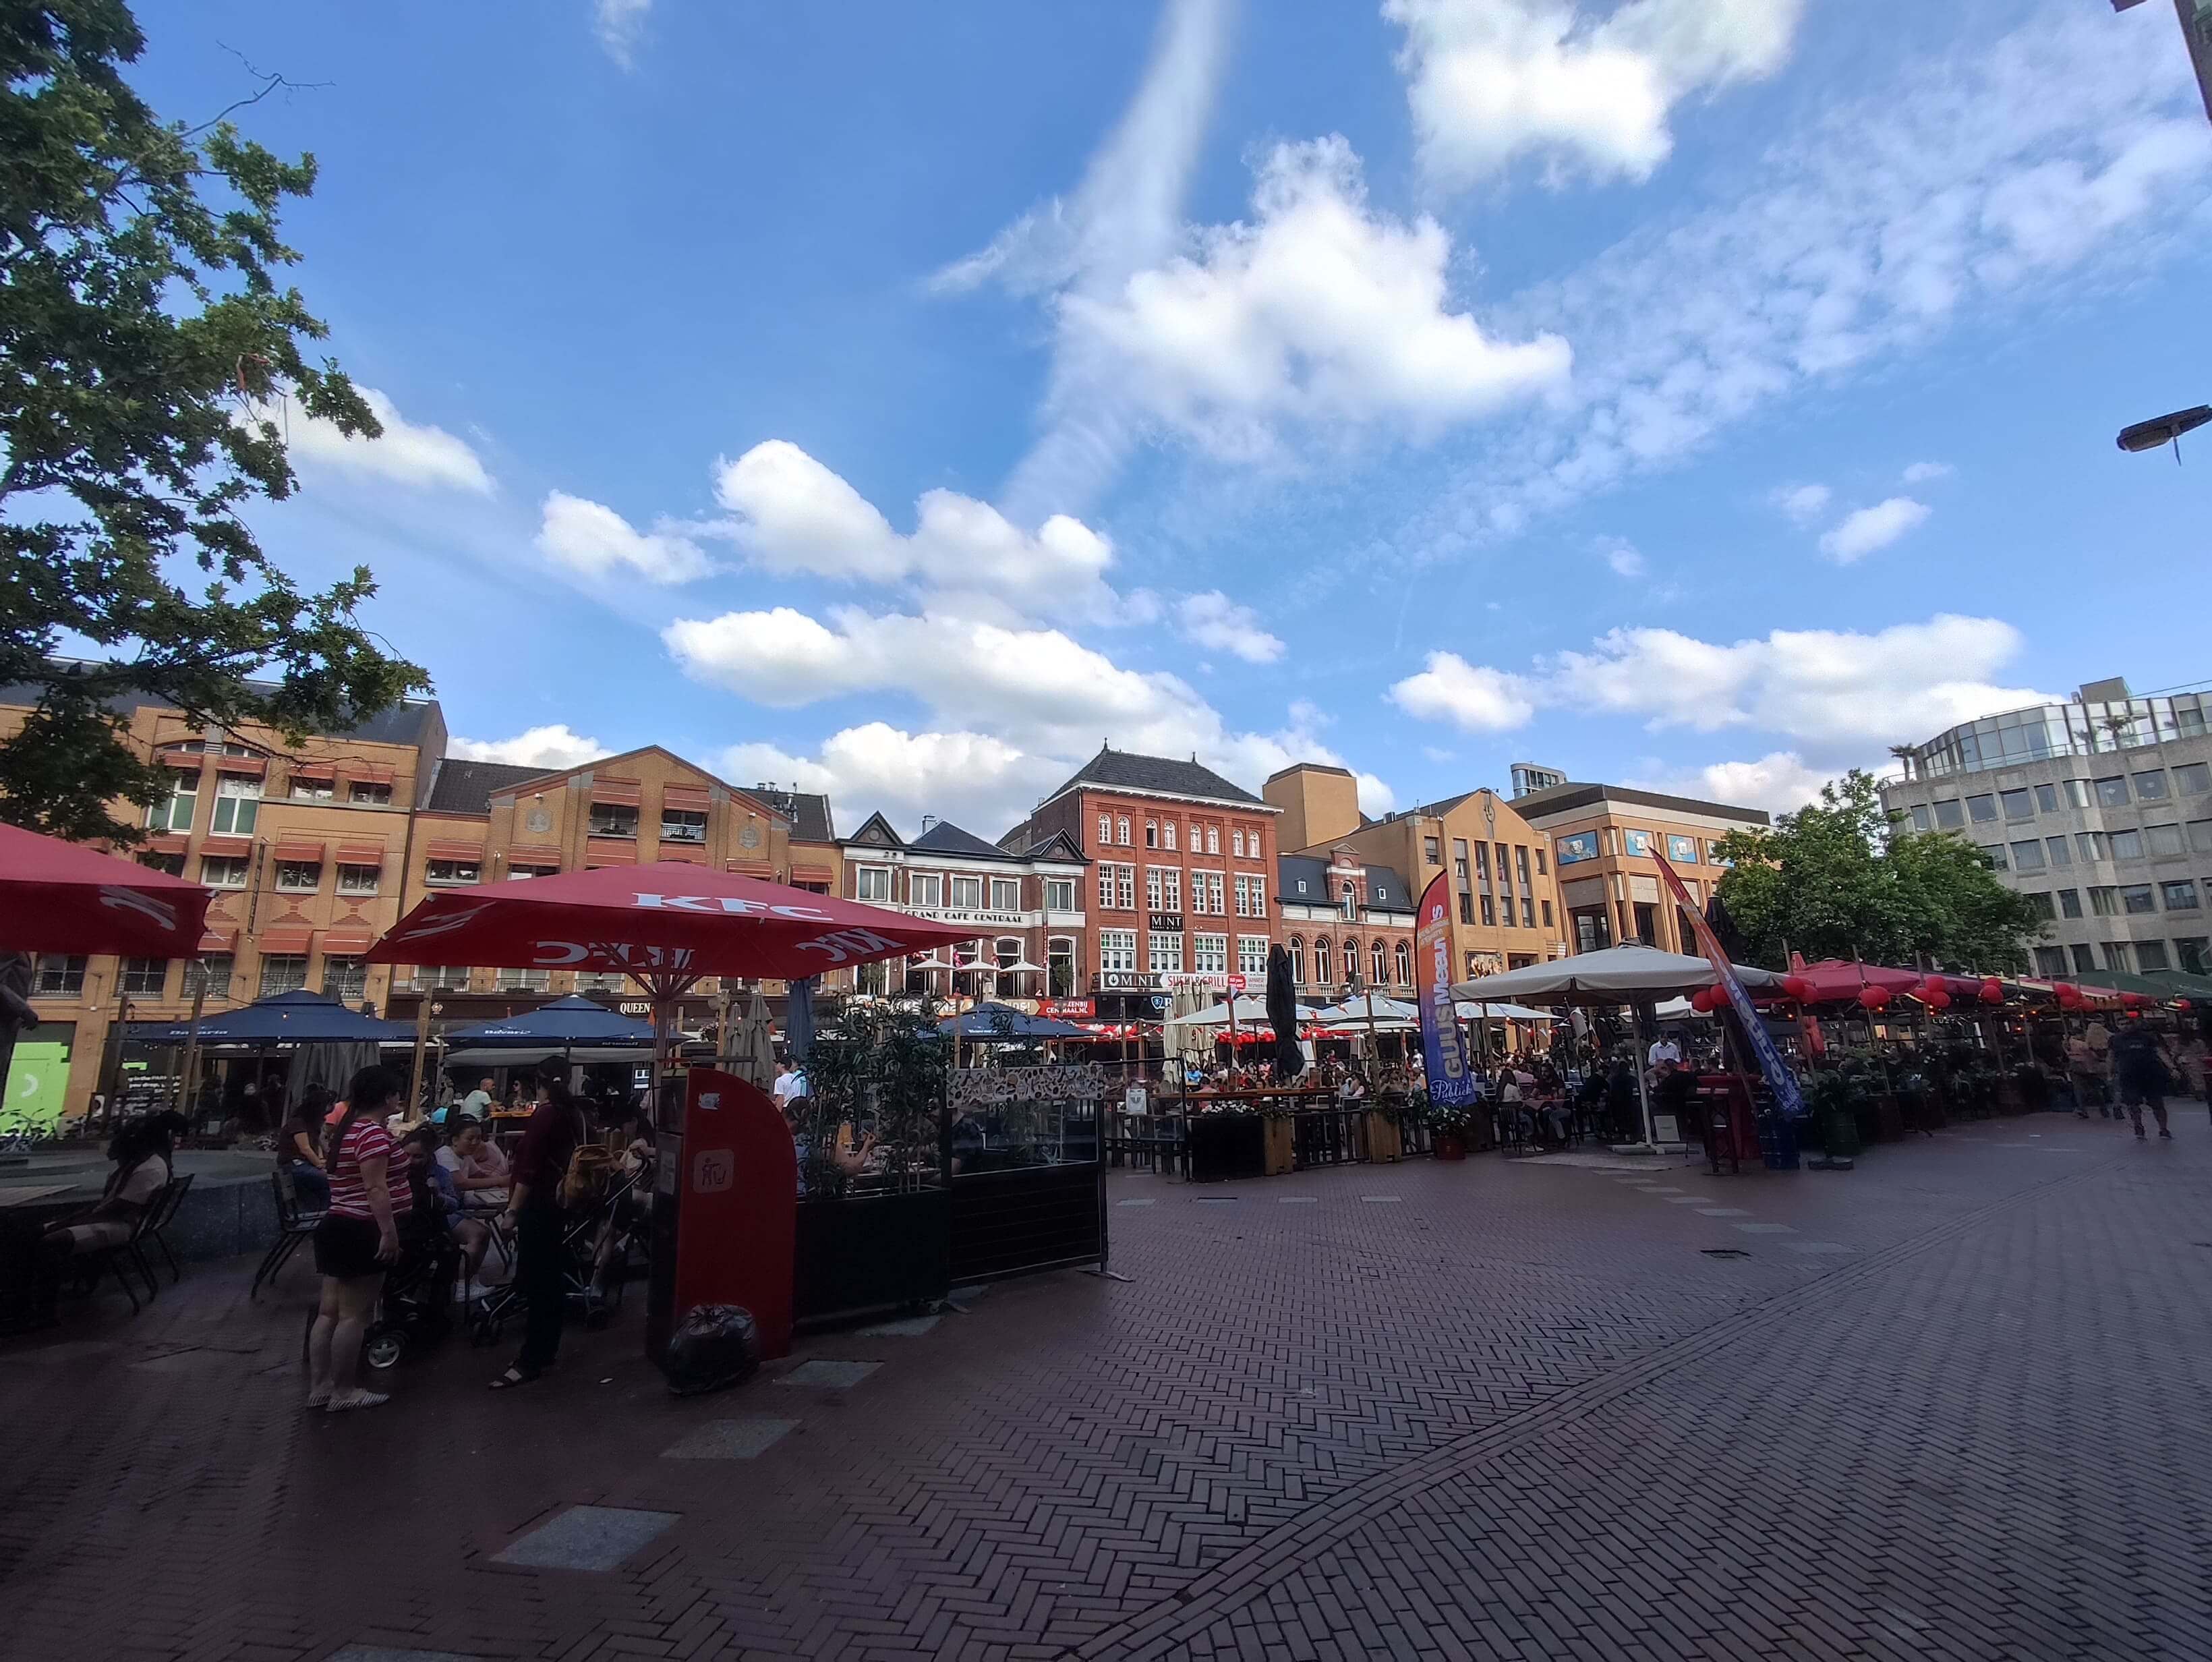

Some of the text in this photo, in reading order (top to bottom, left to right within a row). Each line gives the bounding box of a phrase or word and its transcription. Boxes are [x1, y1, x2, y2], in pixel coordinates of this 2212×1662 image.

[631, 892, 834, 921] KFC
[905, 911, 1024, 923] GRAND CAFE CENTRAAL
[1152, 915, 1182, 927] MINT
[1122, 975, 1156, 987] MINT
[1167, 975, 1194, 987] SUSHI
[1203, 976, 1225, 987] GRILL
[619, 1002, 651, 1014] QUEEN
[1046, 1006, 1088, 1014] CENRAAL.NL
[1434, 1005, 1465, 1079] GUUS
